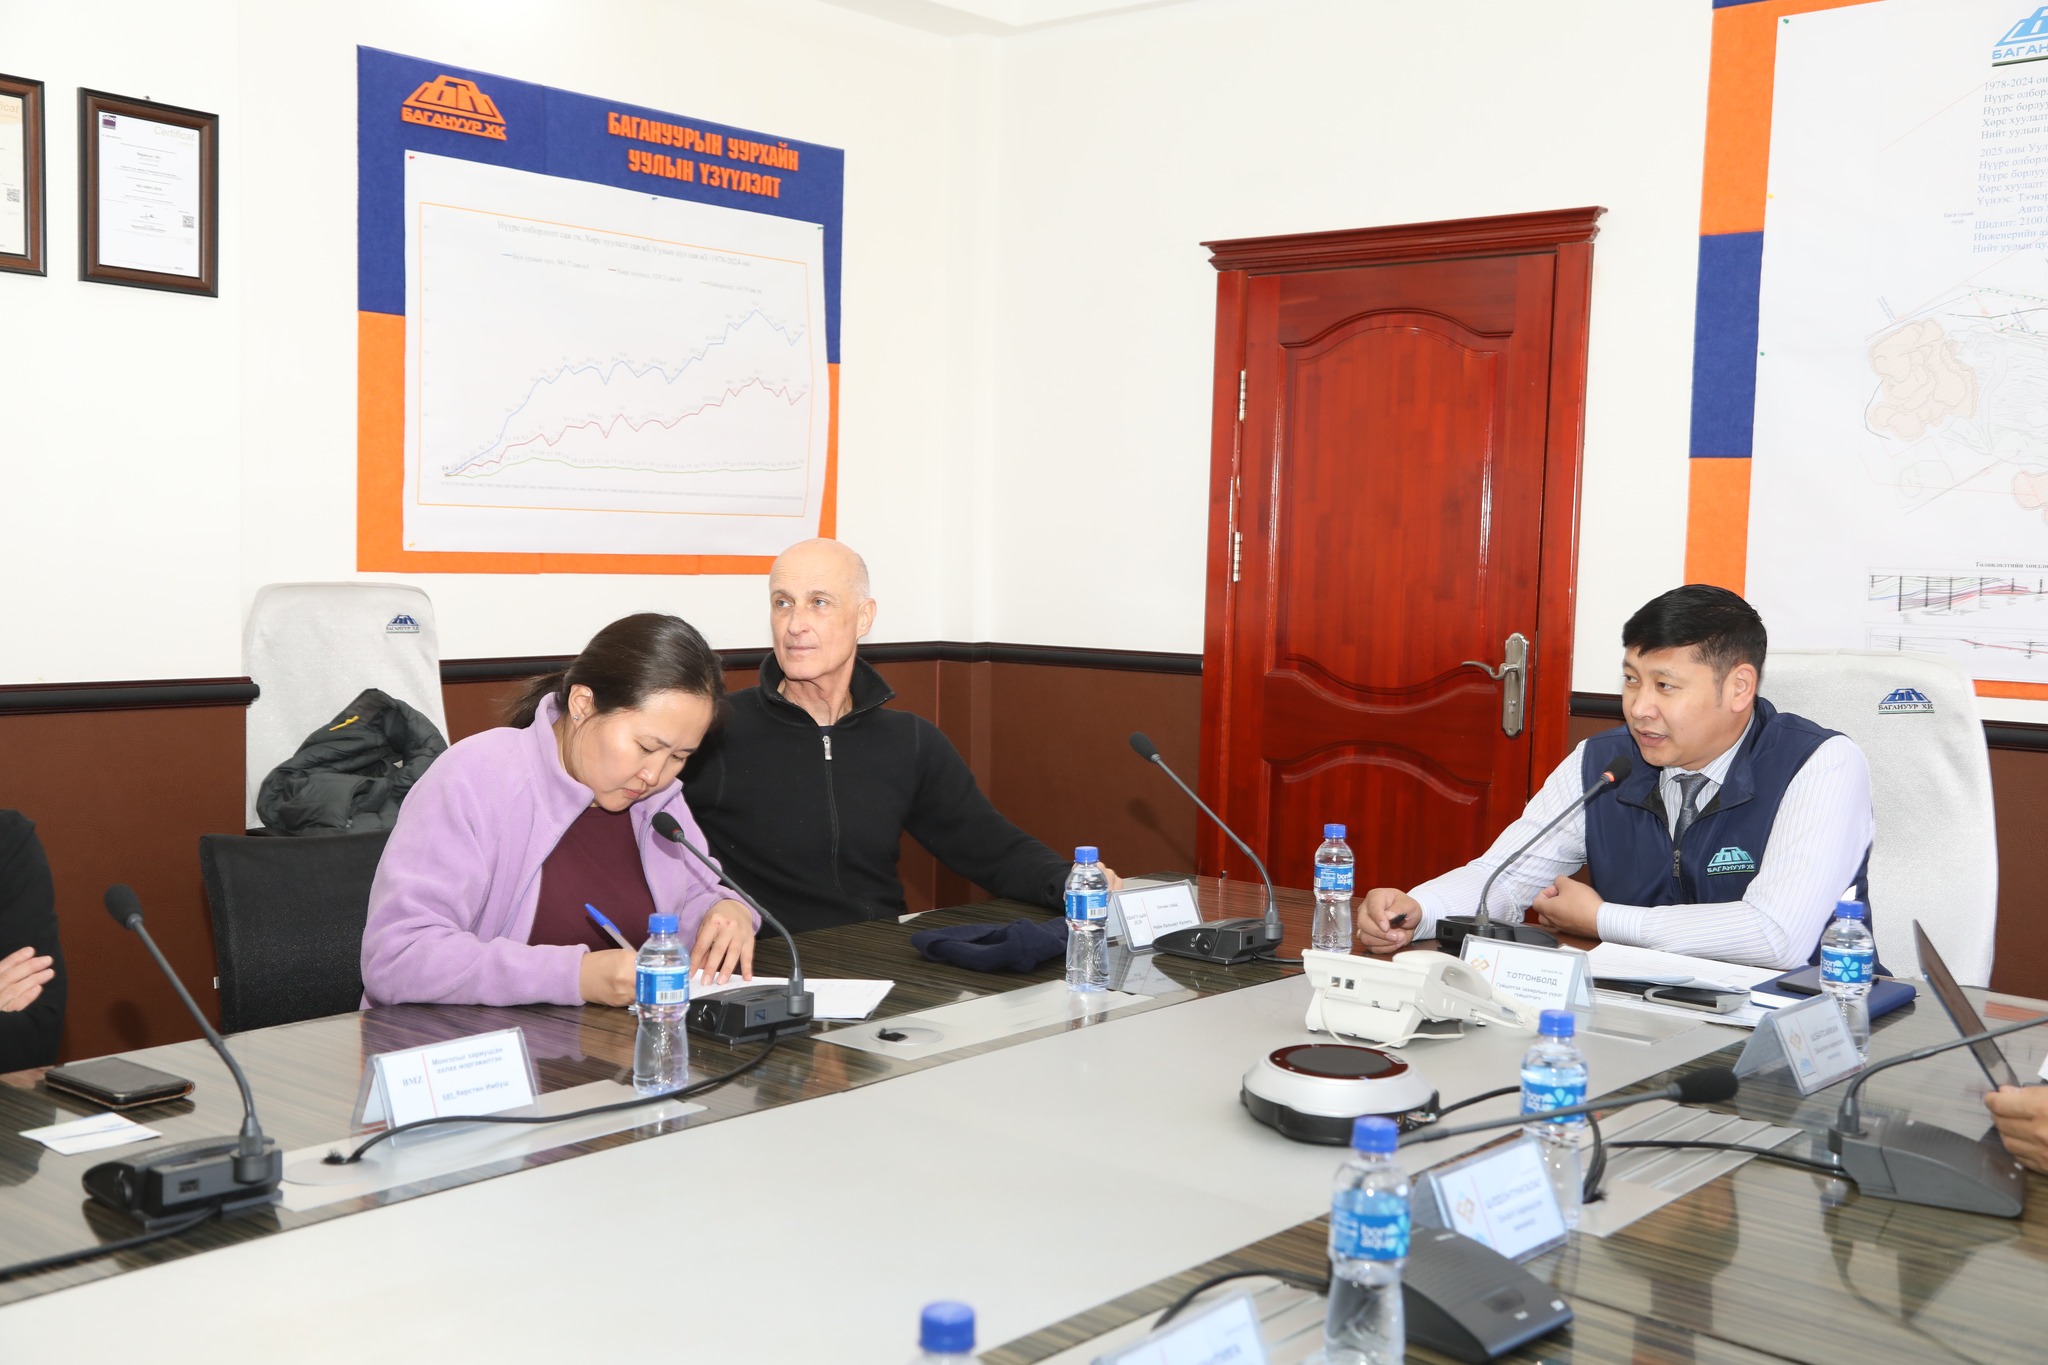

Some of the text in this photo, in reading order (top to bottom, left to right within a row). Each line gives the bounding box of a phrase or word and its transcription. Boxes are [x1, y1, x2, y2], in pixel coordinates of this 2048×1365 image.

[1985, 77, 2033, 90] 1978-2024
[402, 107, 507, 139] БАГАНУУР ХК
[153, 125, 195, 141] Certificat
[607, 112, 799, 172] БАГАНУУРЫН УУРХАЙН
[1979, 146, 2003, 158] 2025
[628, 150, 781, 198] УУЛЫН ҮЗҮҮЛЭЛТ
[1878, 702, 1934, 712] БАГАНУУР ХК
[1706, 864, 1746, 873] БАГАНУУР
[1507, 971, 1558, 986] Т.ОТГОНБОЛД
